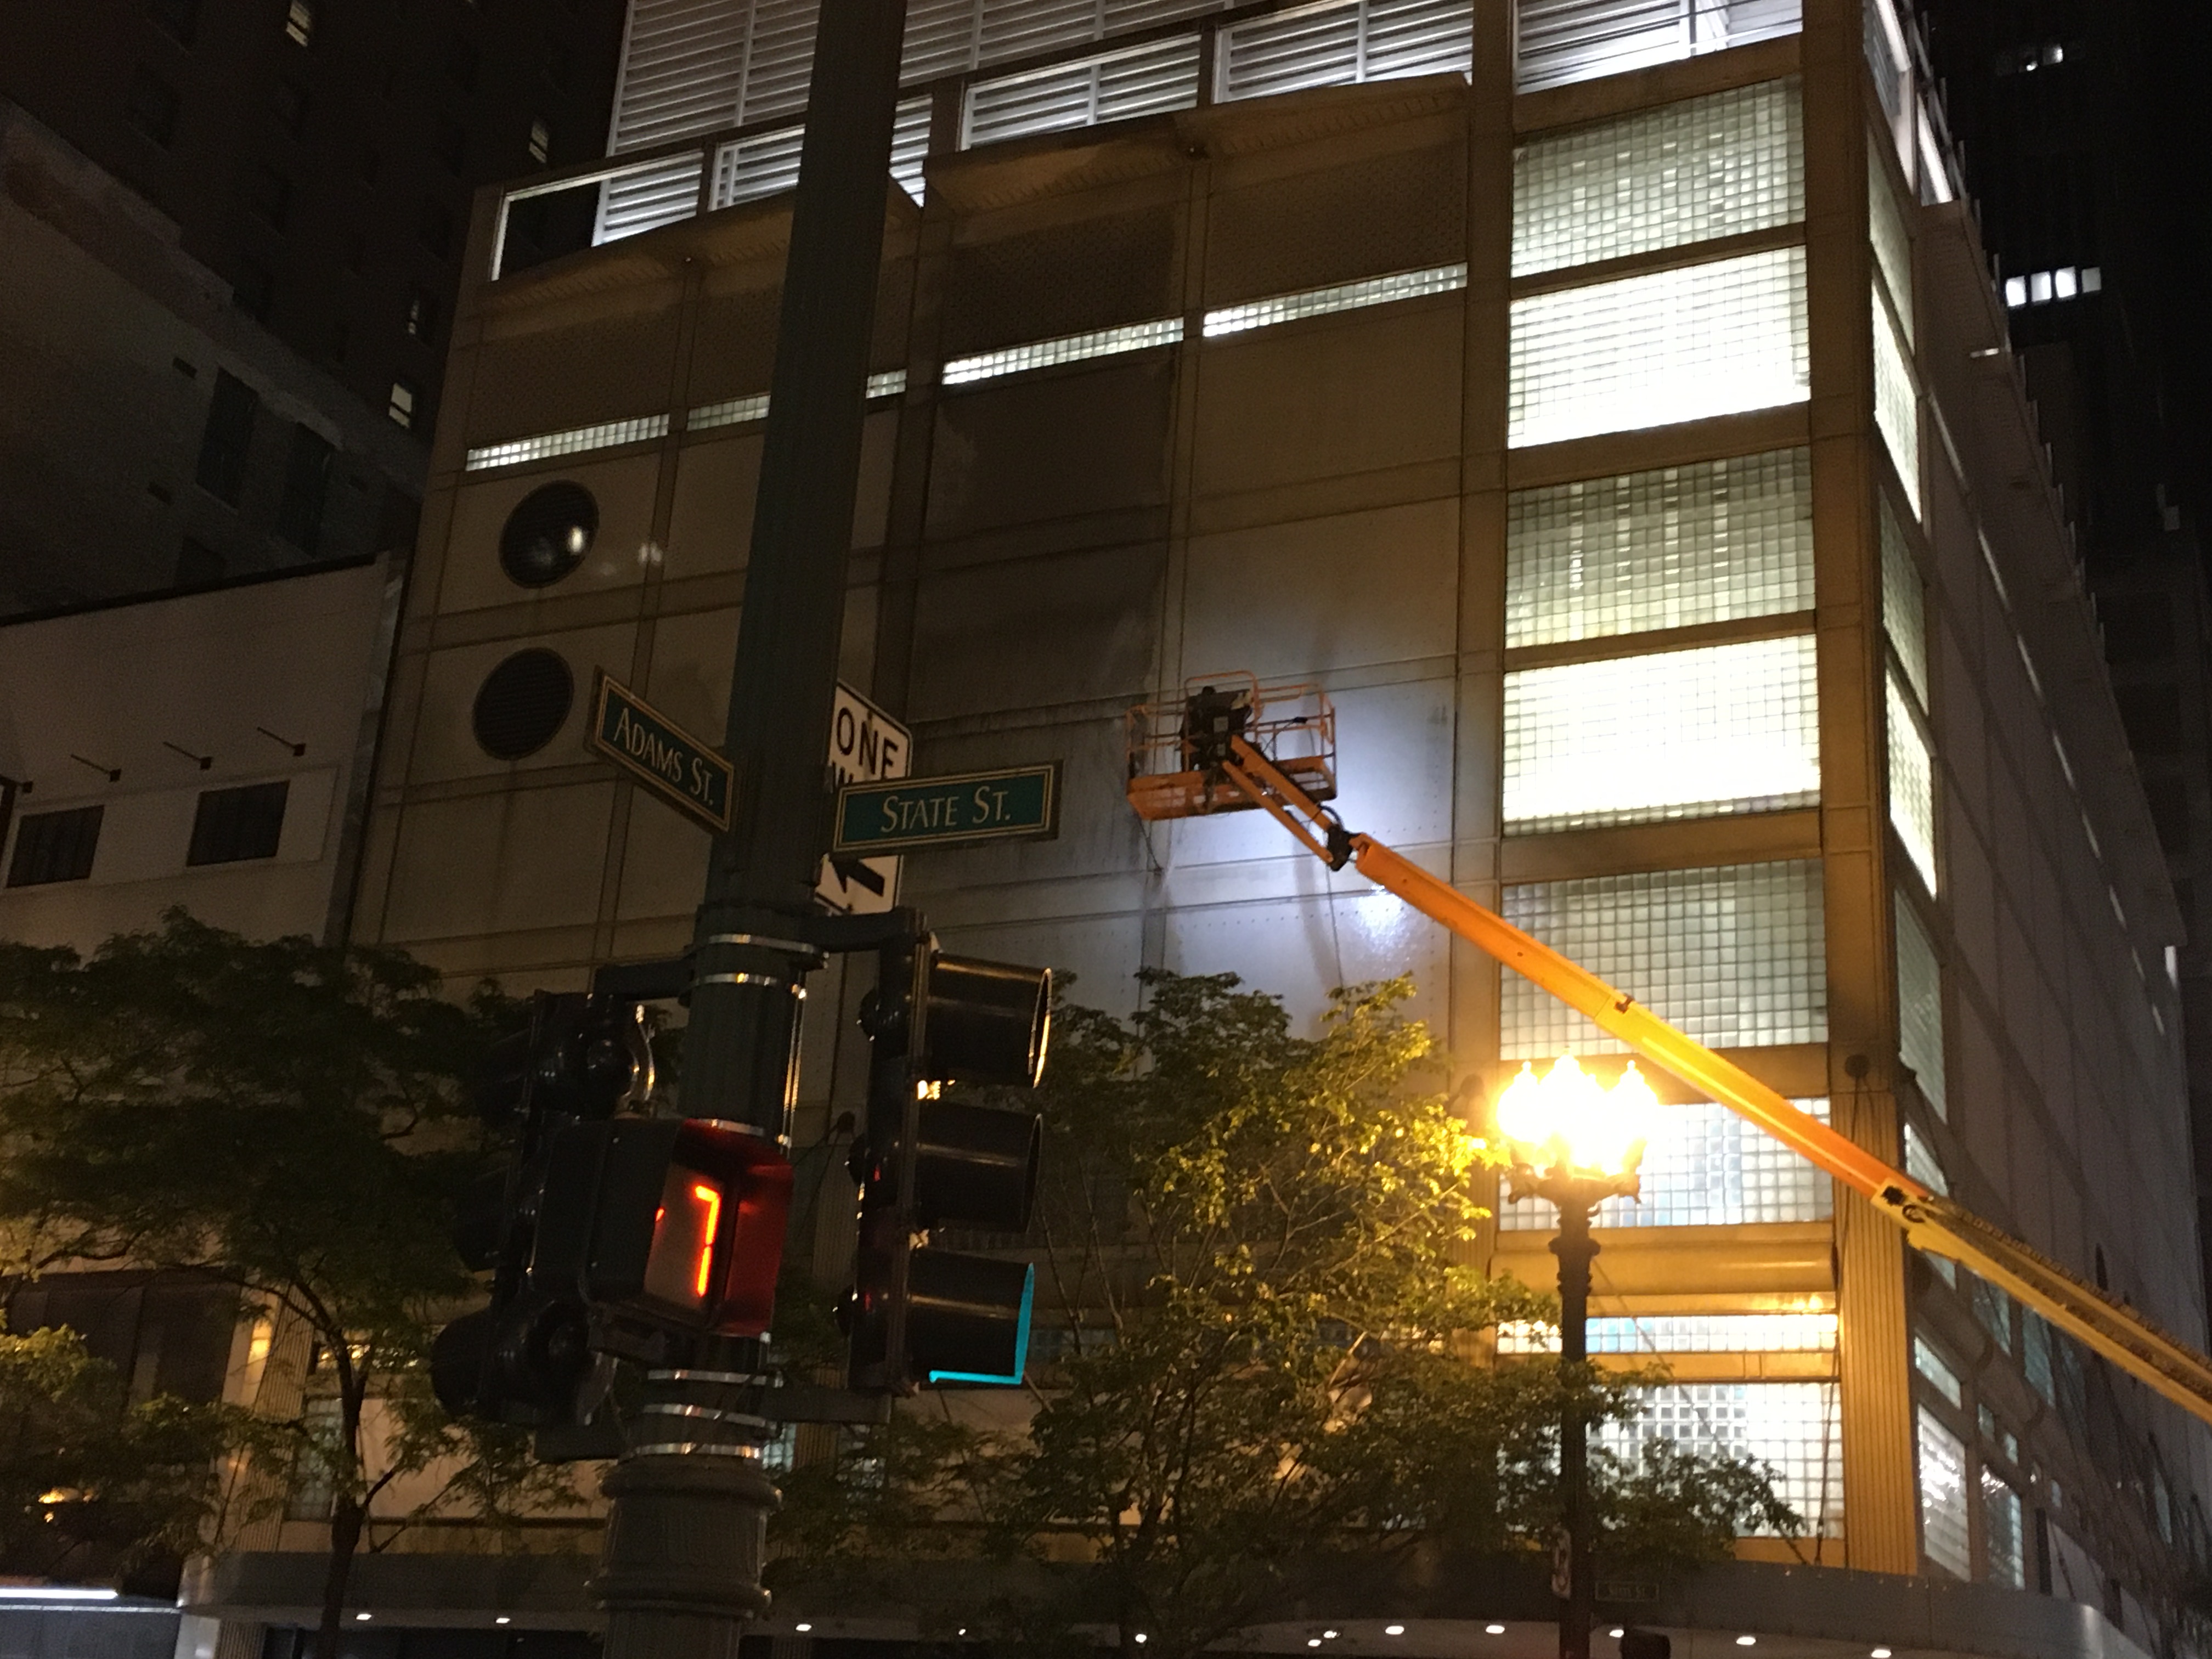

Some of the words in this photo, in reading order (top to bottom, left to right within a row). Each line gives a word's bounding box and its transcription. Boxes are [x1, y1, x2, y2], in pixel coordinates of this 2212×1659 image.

[613, 707, 684, 783] ADAMS
[689, 757, 713, 806] ST.
[880, 795, 960, 833] STATE
[972, 785, 1011, 823] ST.
